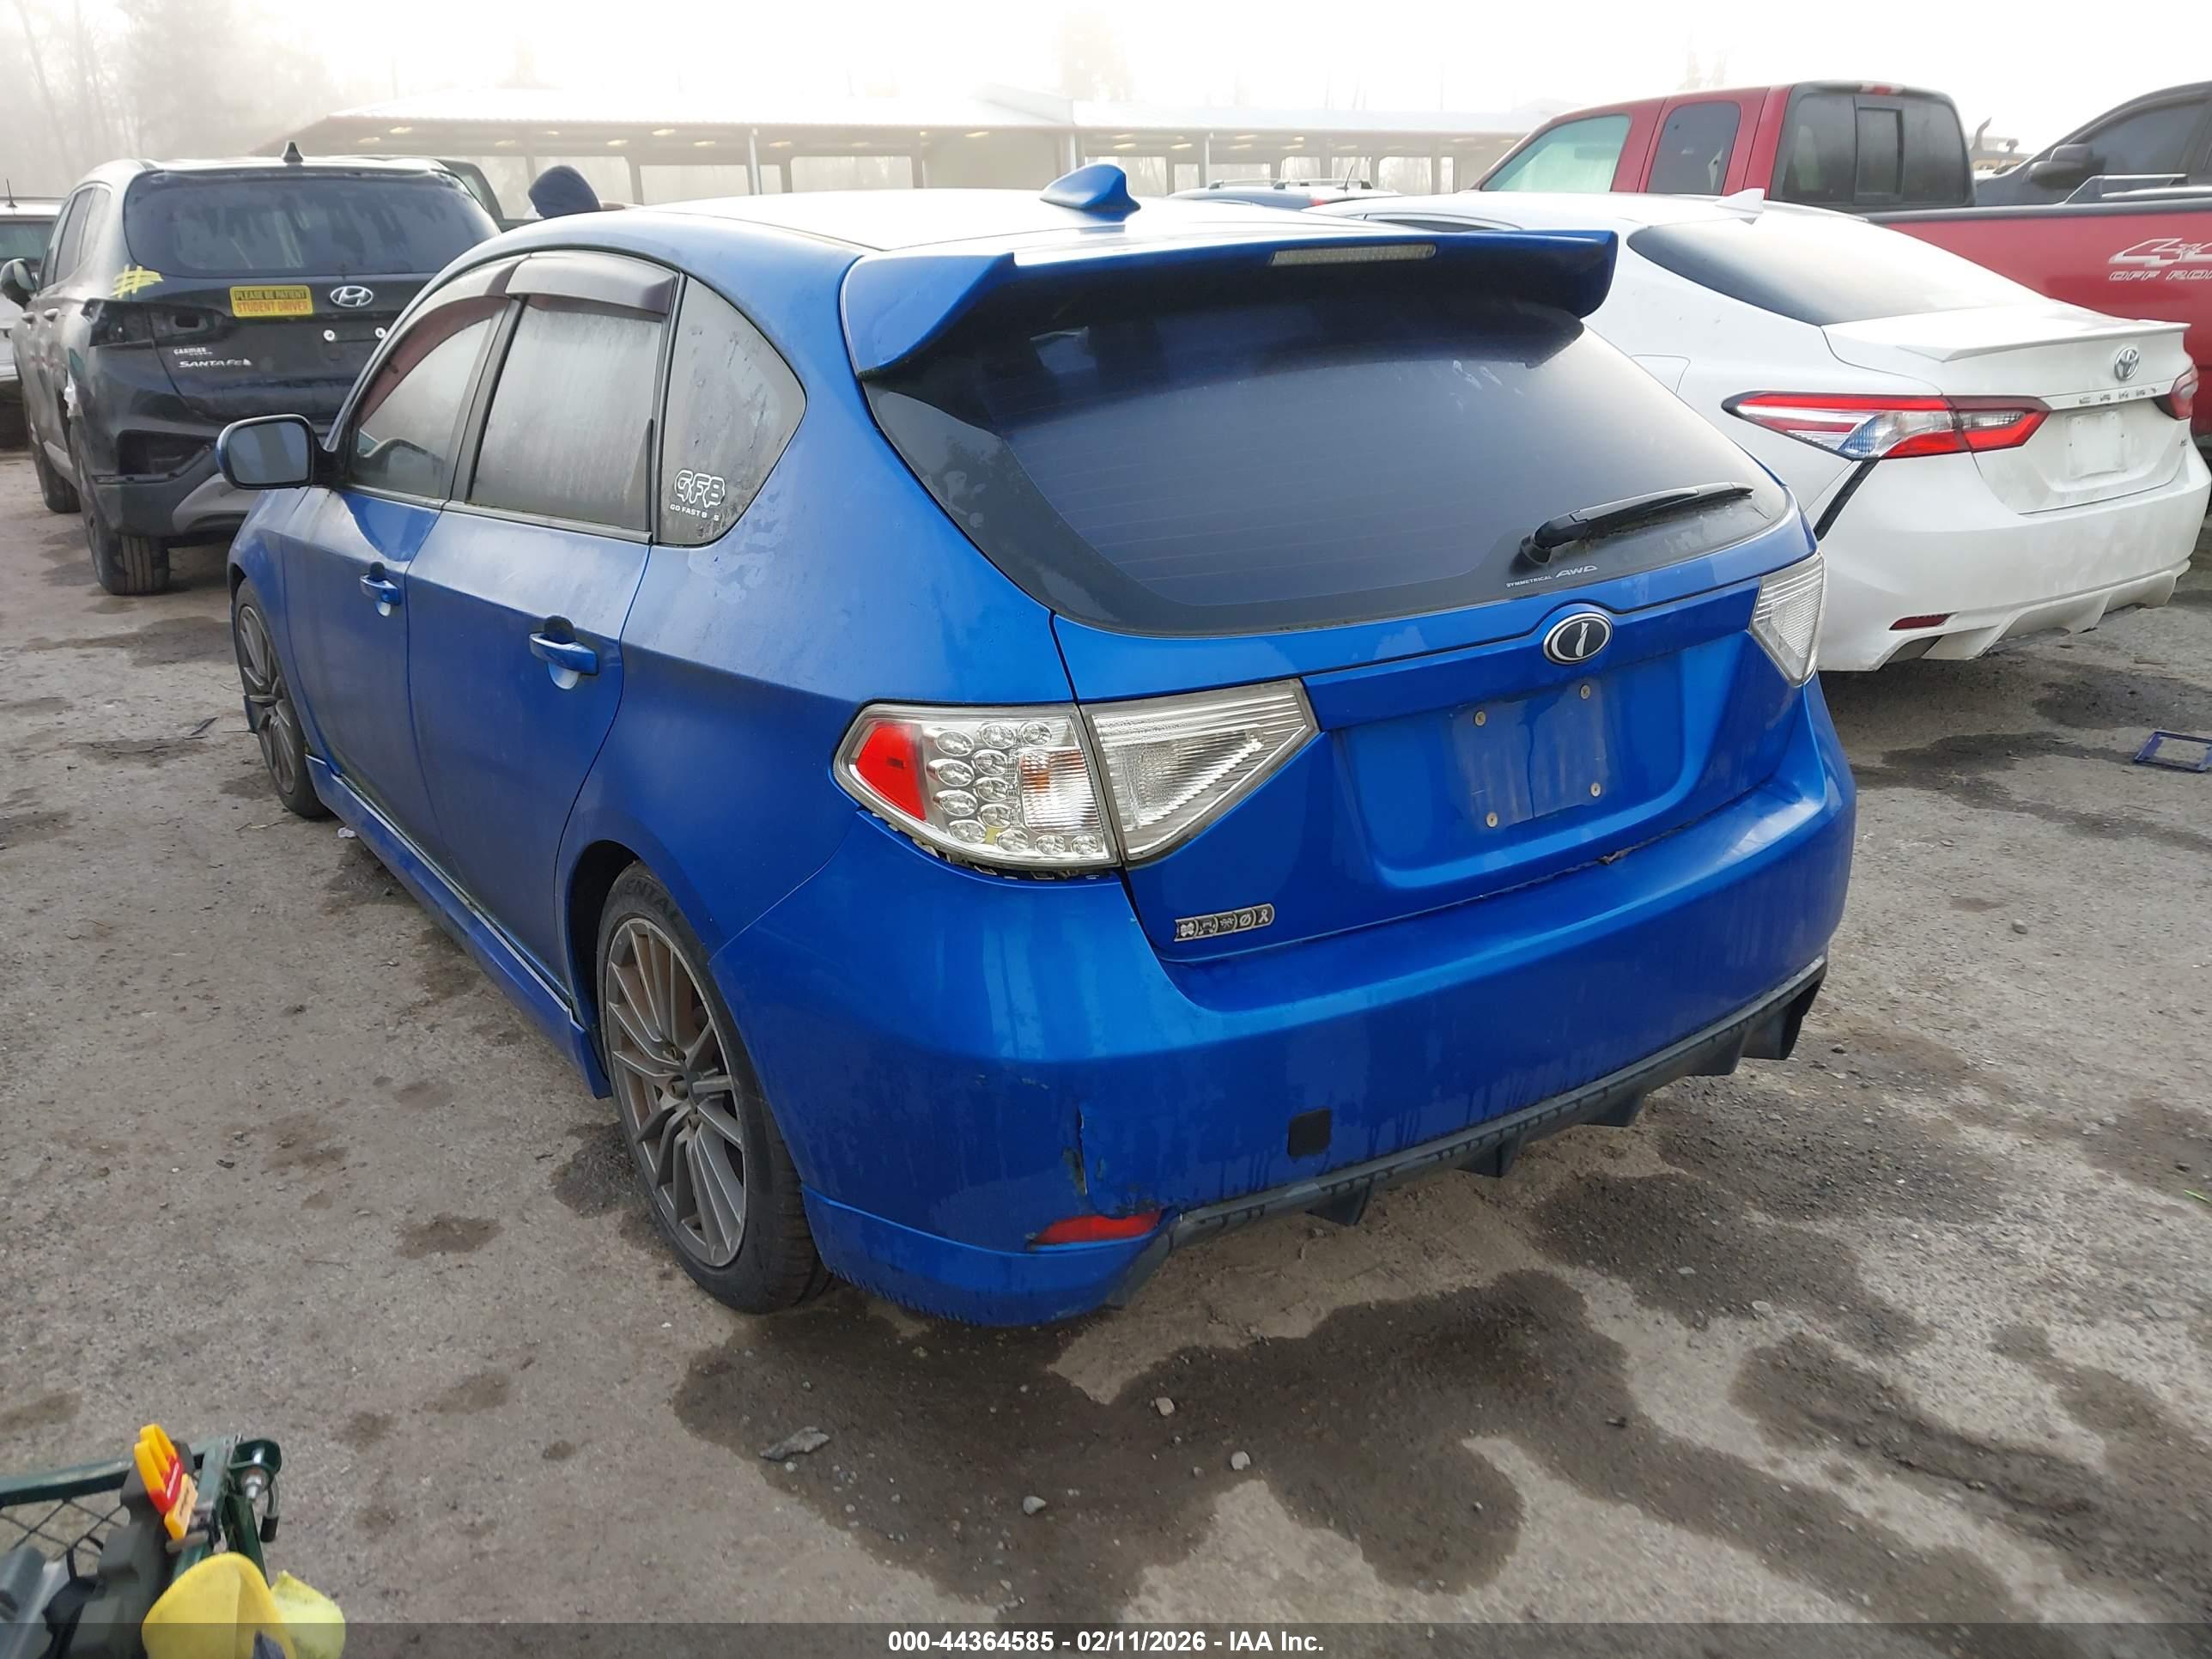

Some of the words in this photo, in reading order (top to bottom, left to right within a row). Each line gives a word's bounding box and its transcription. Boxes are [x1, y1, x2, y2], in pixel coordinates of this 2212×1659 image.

[2109, 270, 2160, 282] OFF
[234, 290, 264, 301] PLEASE
[265, 290, 274, 300] BE
[276, 289, 307, 299] PATIENT
[237, 301, 275, 313] STUDENT
[279, 301, 307, 311] DRIVER
[675, 470, 725, 508] GFB
[670, 503, 681, 512] GO
[681, 507, 701, 516] FAST
[1505, 575, 1553, 588] SYMMETRICAL
[1555, 565, 1599, 579] AWD
